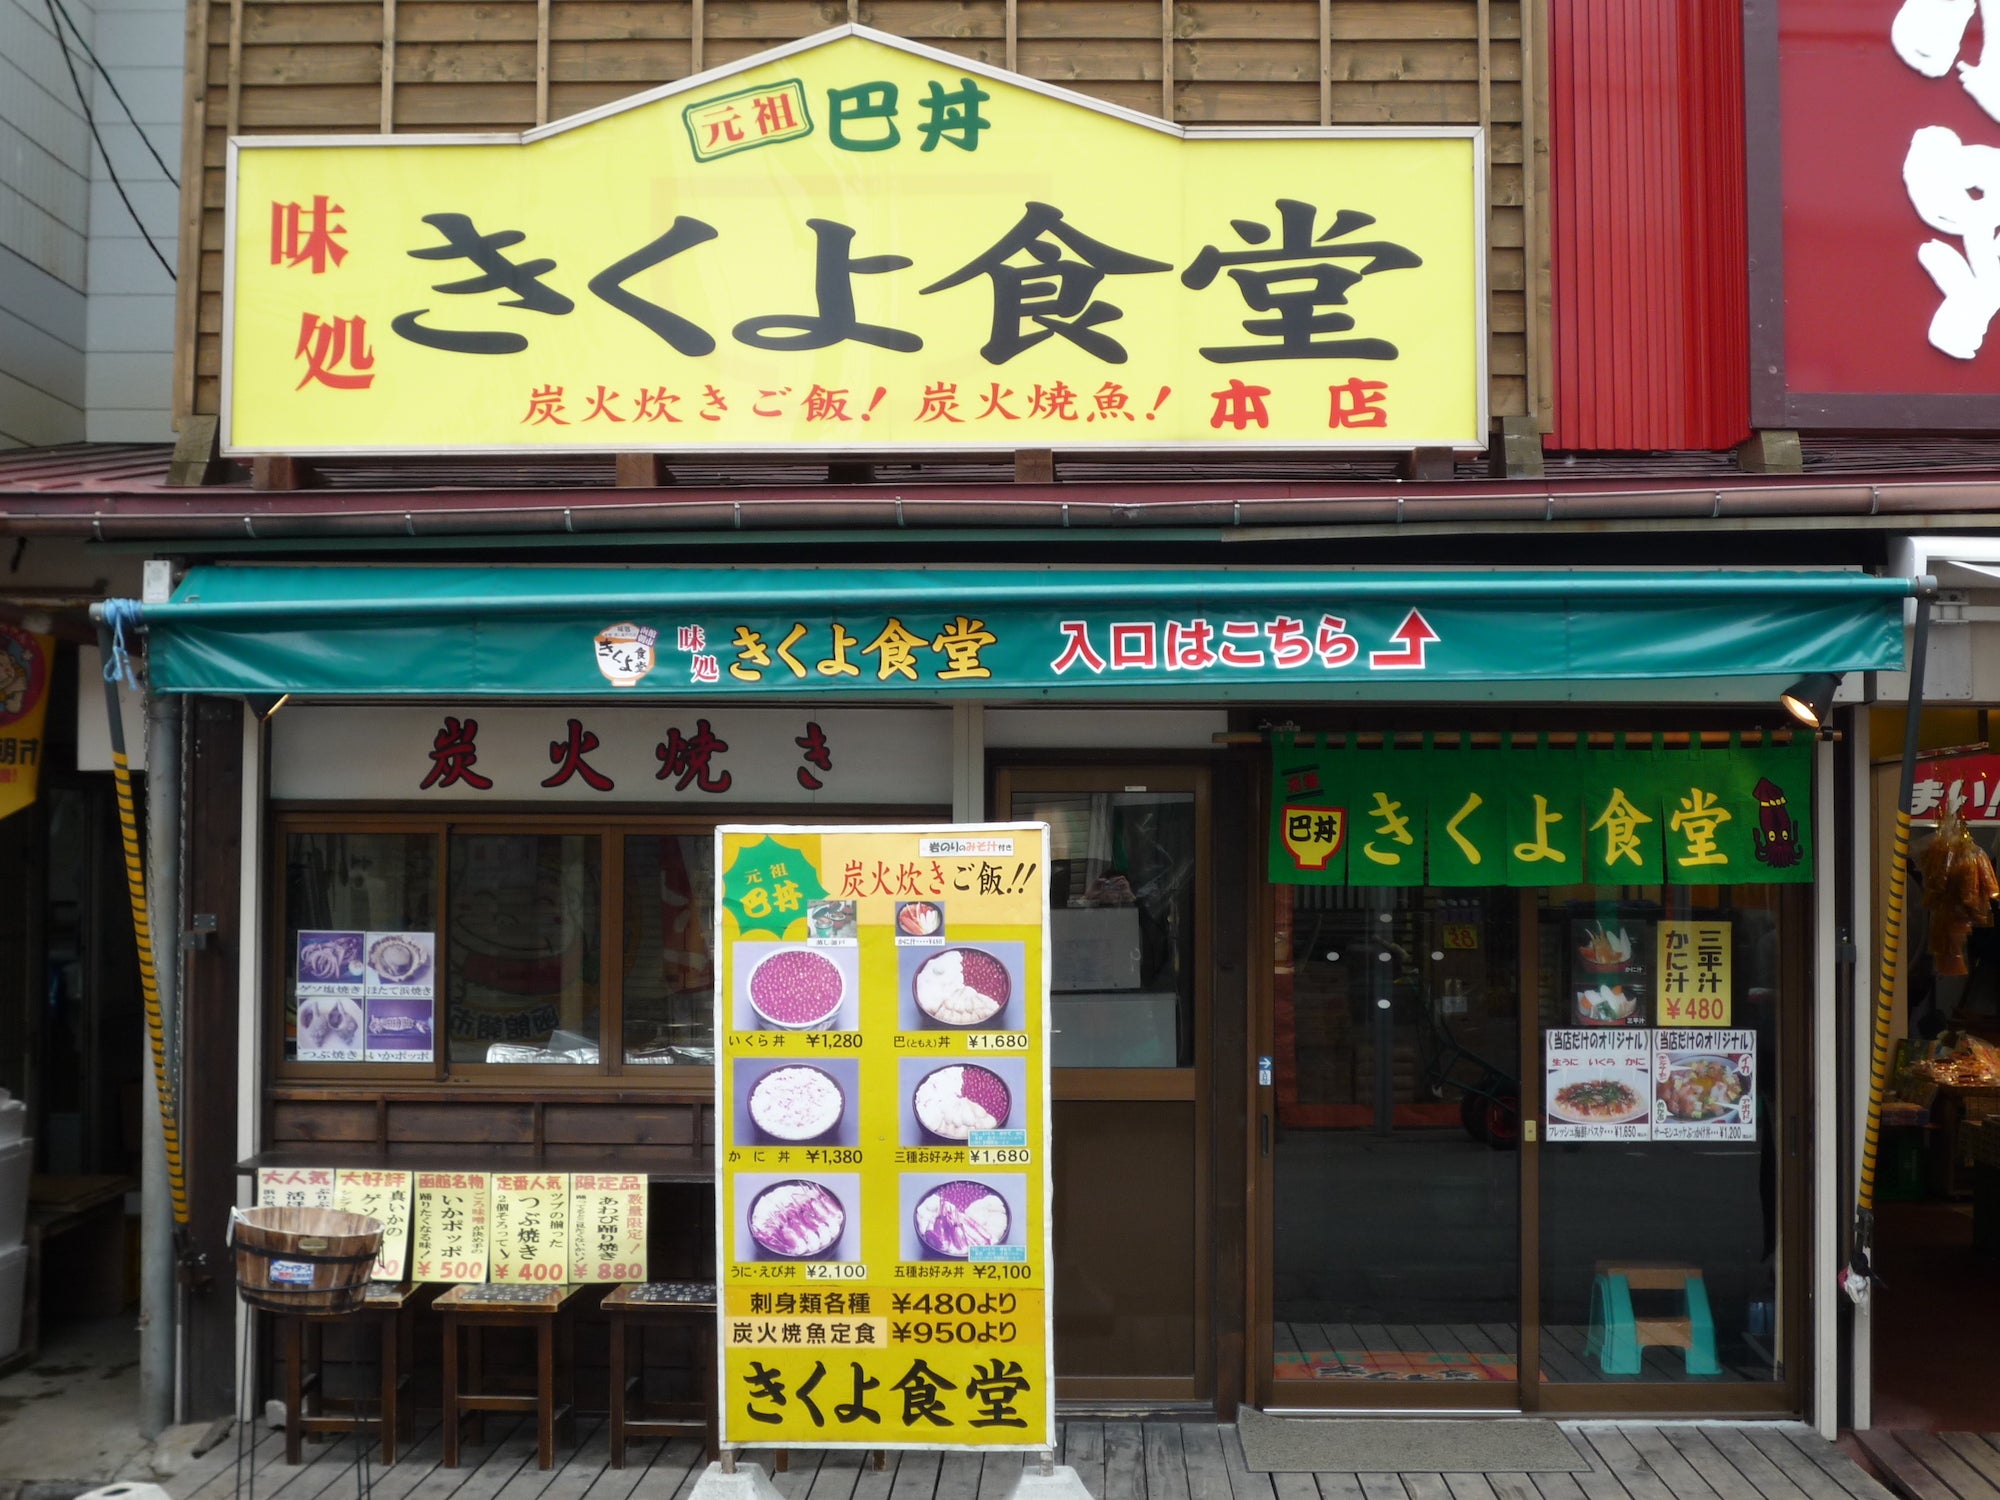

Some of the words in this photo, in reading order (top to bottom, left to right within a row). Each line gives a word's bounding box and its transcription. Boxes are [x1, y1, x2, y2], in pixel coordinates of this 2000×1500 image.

[700, 91, 798, 149] 元祖
[827, 78, 991, 152] 巴丼
[269, 194, 375, 392] 味処
[391, 198, 1423, 365] きくよ食堂
[519, 383, 887, 425] 炭火炊きご飯!
[913, 380, 1171, 424] 炭火焼魚!
[1210, 377, 1389, 430] 本店
[677, 624, 720, 684] 味処
[728, 616, 997, 682] きくよ食堂
[1050, 613, 1359, 675] 入口はこちら
[419, 716, 832, 793] 炭火焼き
[1288, 814, 1337, 844] 巴丼
[1363, 788, 1731, 867] きくよ食堂
[929, 842, 1012, 853] 岩のりのみそ汁付き
[745, 864, 789, 884] 元祖
[740, 879, 803, 919] 巴丼
[1665, 930, 1689, 993] かに汁
[1698, 930, 1722, 992] 三平汁
[300, 985, 361, 994] ゲソ塩焼き
[366, 986, 432, 996] ほたて浜焼き
[1666, 998, 1724, 1020] ¥480
[728, 1035, 785, 1047] いくら丼
[806, 1033, 863, 1048] ¥1,280
[893, 1035, 950, 1049] 巴(ともえ)丼
[968, 1034, 1028, 1047] ¥1,680
[303, 1050, 358, 1060] つぶ焼き
[1588, 1058, 1615, 1066] いくら
[728, 1151, 789, 1163] かに丼
[806, 1149, 863, 1164] ¥1,380
[894, 1152, 965, 1164] 三種お好み丼
[969, 1149, 1029, 1163] ¥1,680
[262, 1171, 330, 1186] 大人気
[341, 1172, 406, 1187] 大好評
[418, 1174, 485, 1188] 函館名物
[496, 1175, 562, 1190] 定番人気
[575, 1175, 641, 1190] 限定品
[386, 1190, 406, 1237] 真いかの
[549, 1193, 564, 1248] ツブの揃った
[518, 1196, 540, 1260] つぶ焼き
[597, 1196, 618, 1261] あわび踊り焼き
[417, 1261, 431, 1276] ¥
[440, 1262, 482, 1279] 500
[495, 1263, 509, 1279] ¥
[518, 1263, 563, 1281] 400
[574, 1263, 588, 1278] ¥
[597, 1263, 643, 1279] 880
[730, 1265, 796, 1278] うに・えび丼
[807, 1265, 865, 1279] ¥2,100
[894, 1266, 964, 1279] 五種お好み丼
[973, 1265, 1031, 1280] ¥2,100
[750, 1292, 870, 1315] 刺身類各種
[892, 1293, 1017, 1315] ¥480より
[732, 1322, 876, 1345] 炭火焼魚定食
[892, 1321, 1017, 1344] ¥950より
[743, 1358, 1031, 1428] きくよ食堂
